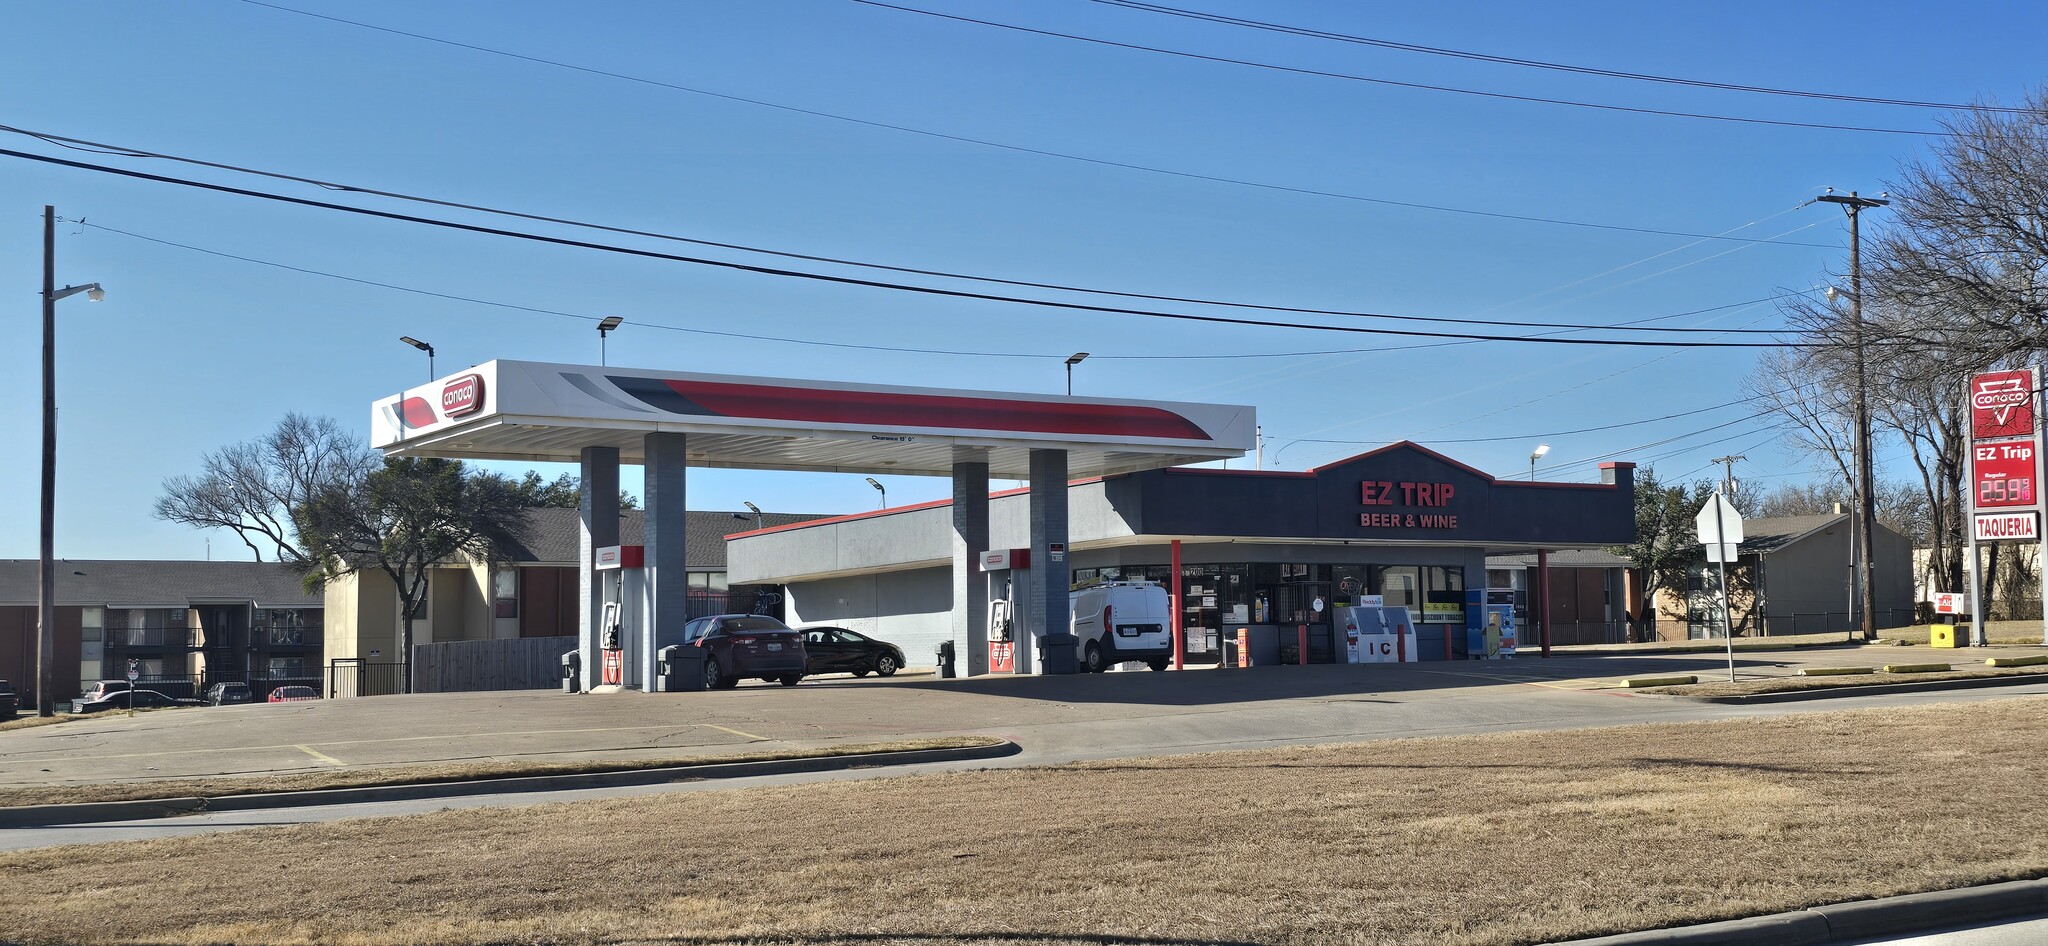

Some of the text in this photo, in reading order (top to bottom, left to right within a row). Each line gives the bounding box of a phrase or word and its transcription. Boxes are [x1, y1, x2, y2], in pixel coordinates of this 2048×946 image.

[1976, 445, 2032, 461] EZ Trip
[1361, 480, 1455, 507] EZ TRIP
[1360, 513, 1457, 529] BEER & WINE
[1977, 516, 2033, 537] TAQUERIA
